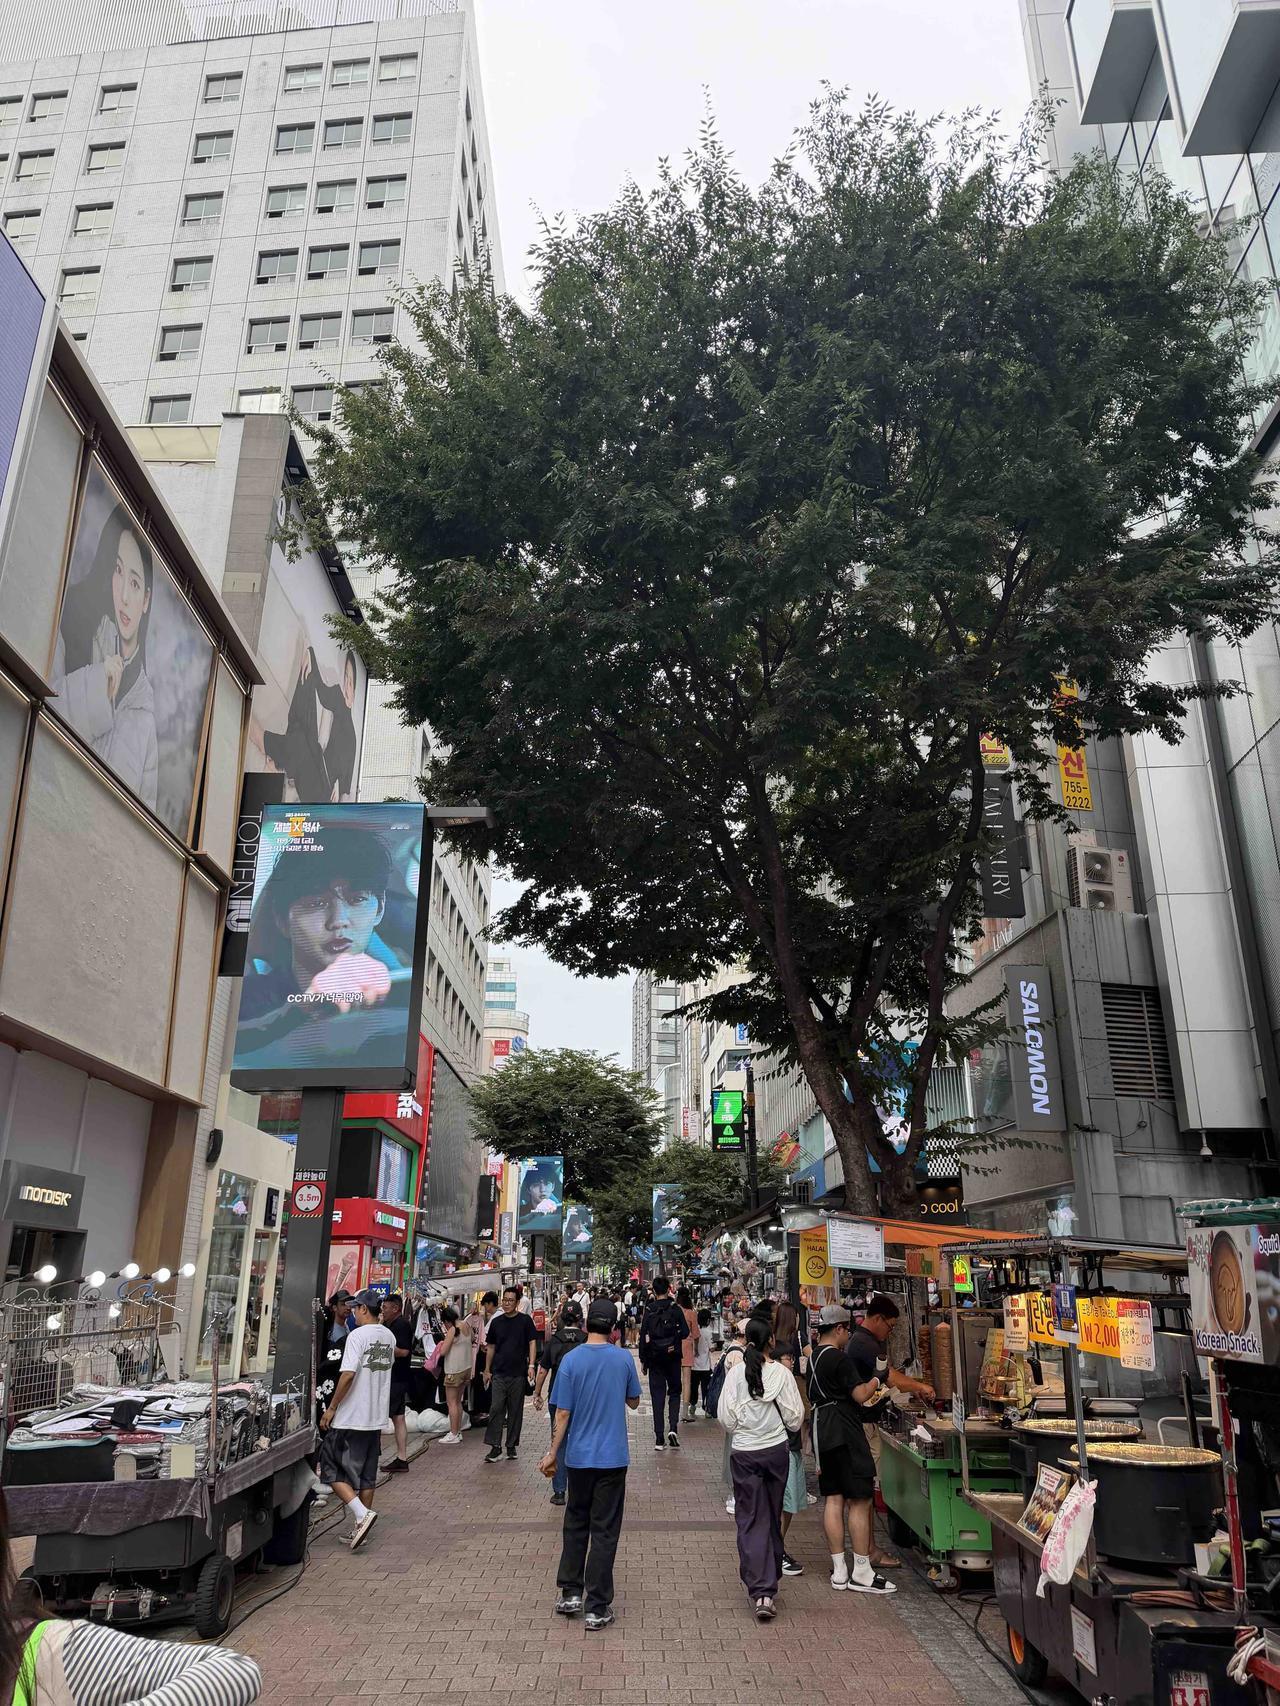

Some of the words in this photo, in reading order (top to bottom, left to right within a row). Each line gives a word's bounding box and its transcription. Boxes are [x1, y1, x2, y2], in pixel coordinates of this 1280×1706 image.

[1064, 781, 1088, 793] 755-
[1066, 796, 1091, 809] 2222
[287, 992, 325, 1004] CCTV가
[326, 992, 345, 1004] 너무
[1019, 980, 1051, 1115] SALOMON
[294, 1171, 326, 1180] 제한높이
[298, 1193, 320, 1202] 3.5m
[931, 1199, 959, 1213] cool
[1258, 1235, 1280, 1255] Squid
[372, 1287, 387, 1295] TAX
[1196, 1328, 1228, 1350] Korean
